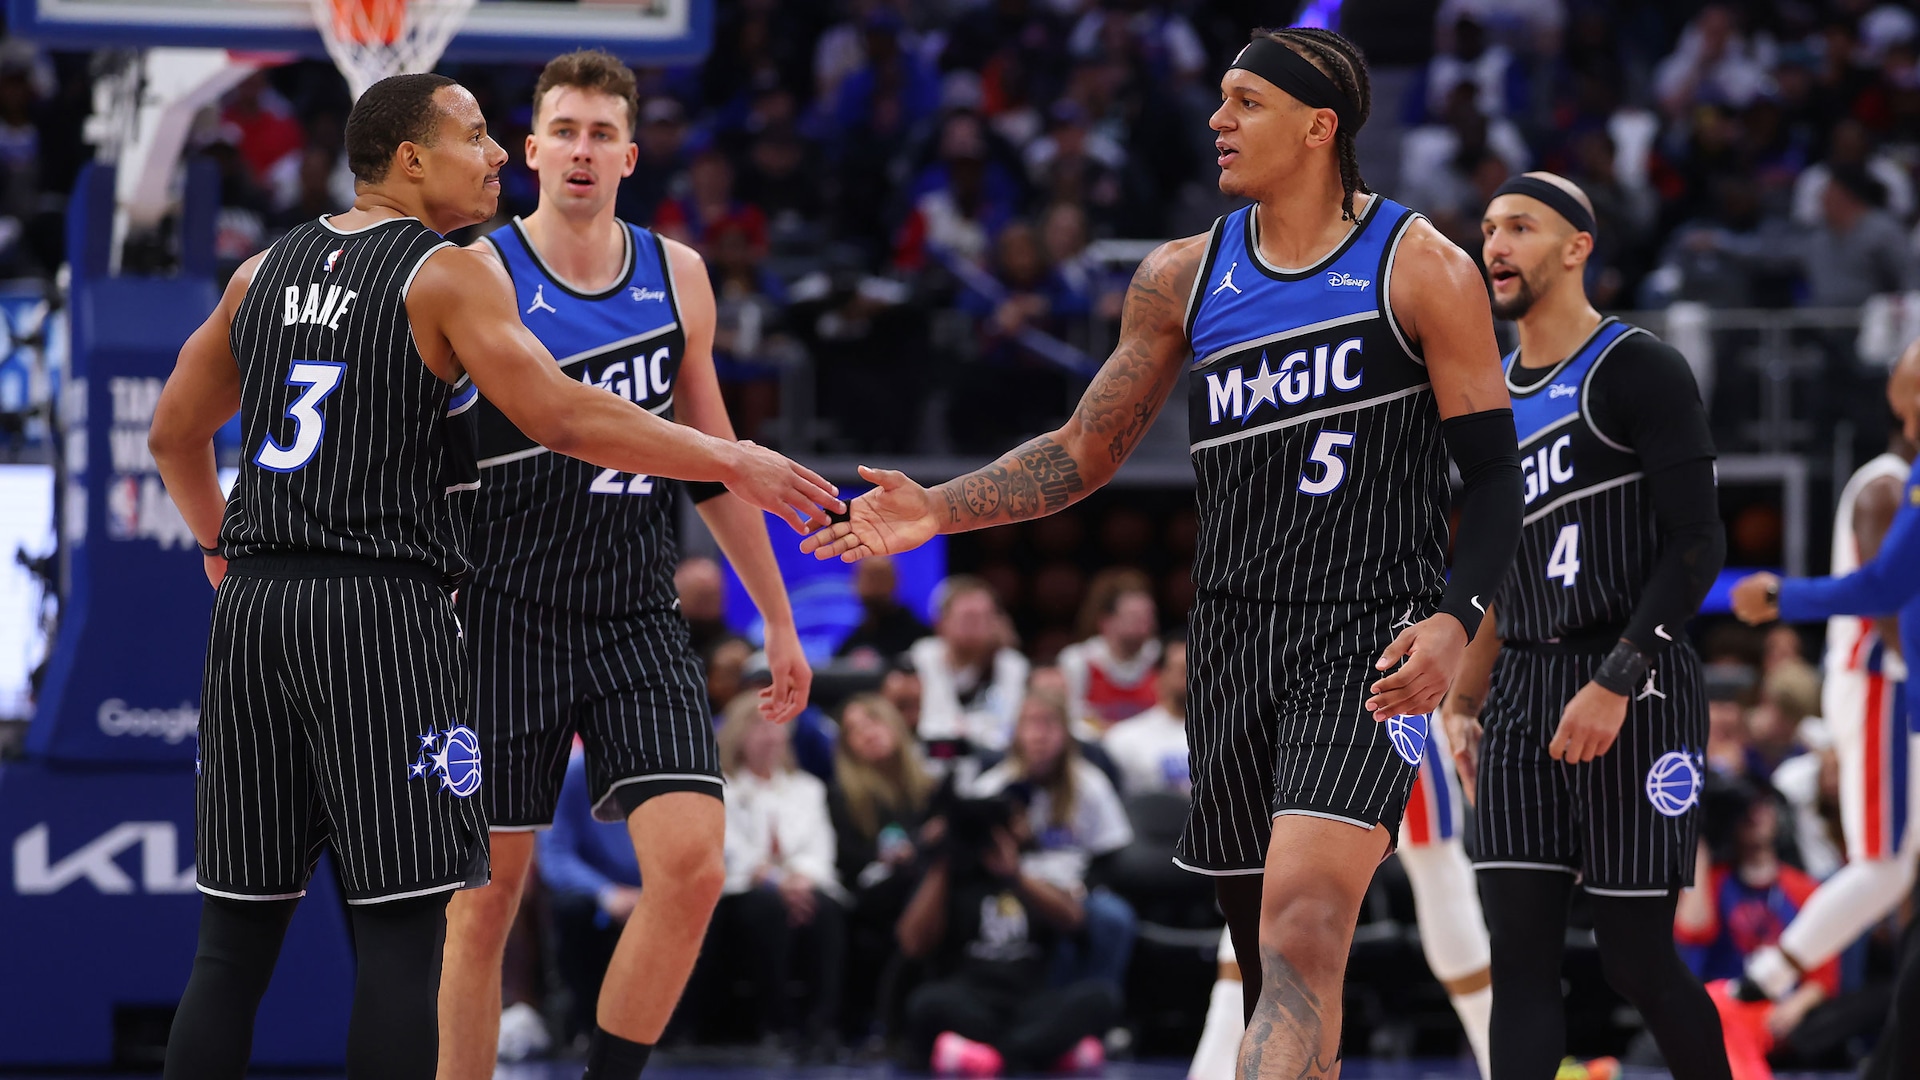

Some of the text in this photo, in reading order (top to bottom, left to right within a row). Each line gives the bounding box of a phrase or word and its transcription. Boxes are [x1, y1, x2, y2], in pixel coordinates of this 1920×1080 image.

[284, 283, 357, 331] BANE
[629, 286, 665, 302] Disney
[1327, 272, 1371, 292] Disney
[581, 345, 672, 403] GIC
[252, 359, 348, 473] 3
[1297, 430, 1357, 497] 5
[1520, 433, 1575, 506] GIC
[1546, 522, 1581, 588] 4
